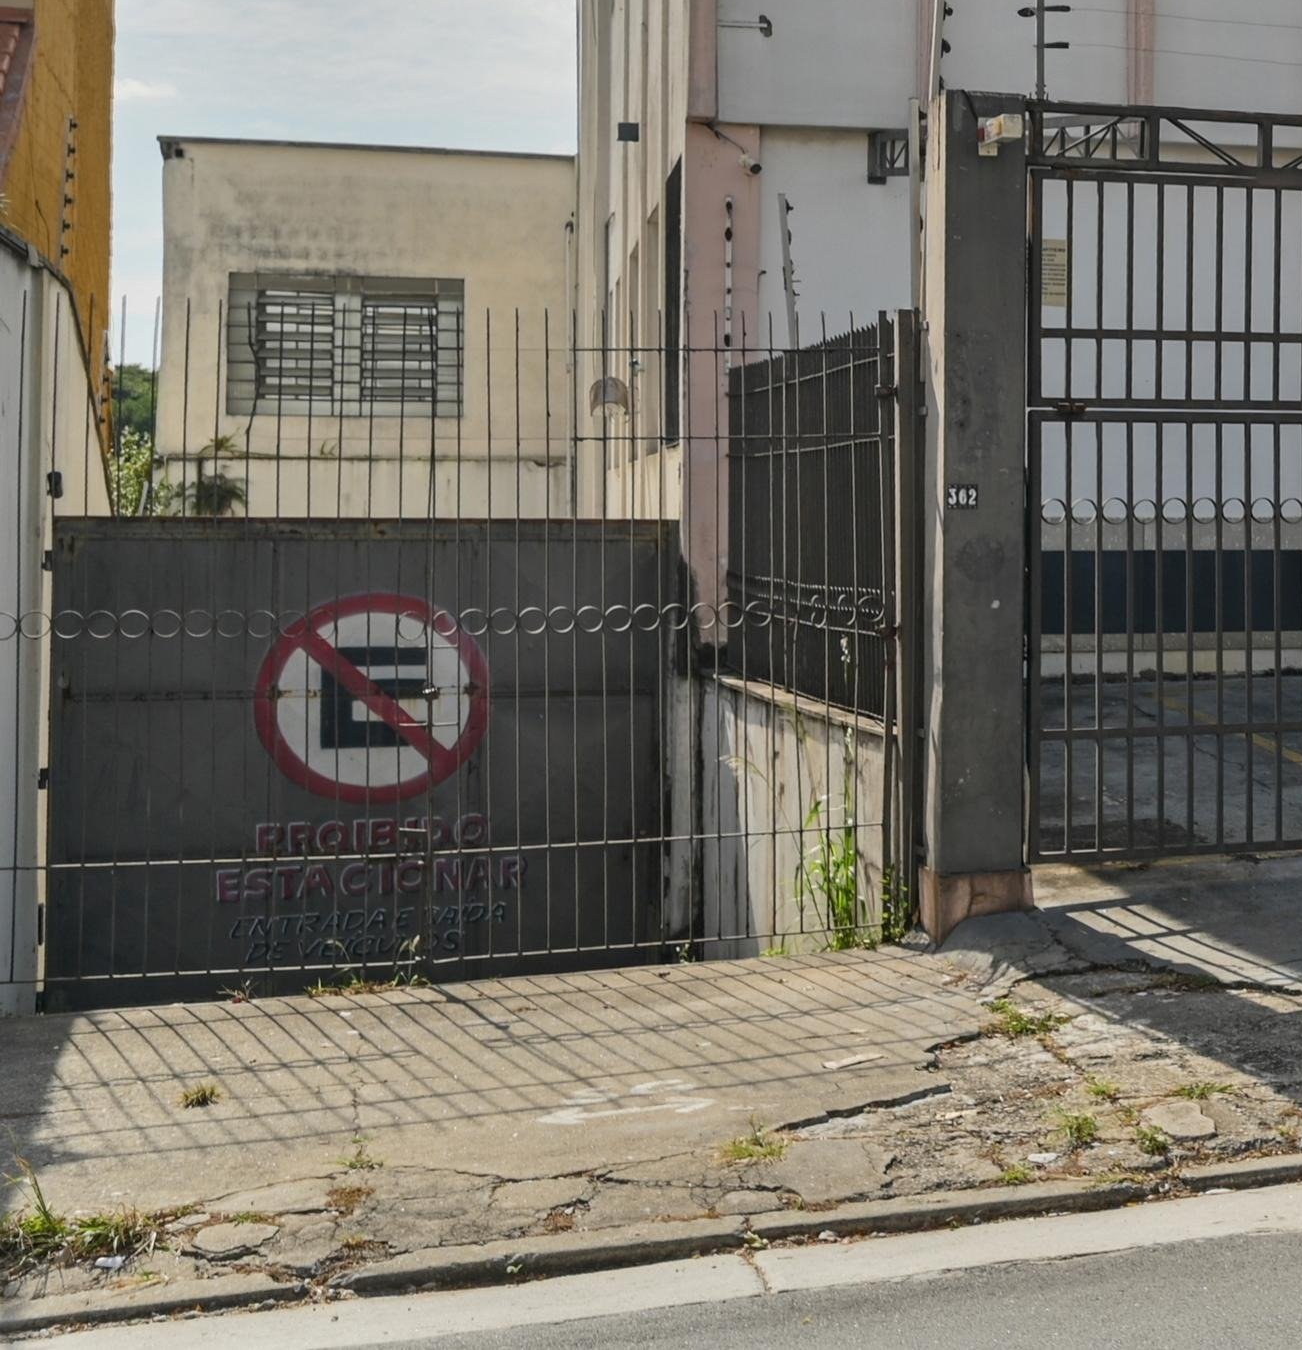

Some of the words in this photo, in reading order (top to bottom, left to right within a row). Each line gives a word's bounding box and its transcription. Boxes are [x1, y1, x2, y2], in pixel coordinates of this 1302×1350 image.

[948, 488, 977, 506] 362
[255, 813, 490, 854] PROIBIDO
[216, 856, 529, 903] ESTACIONAR
